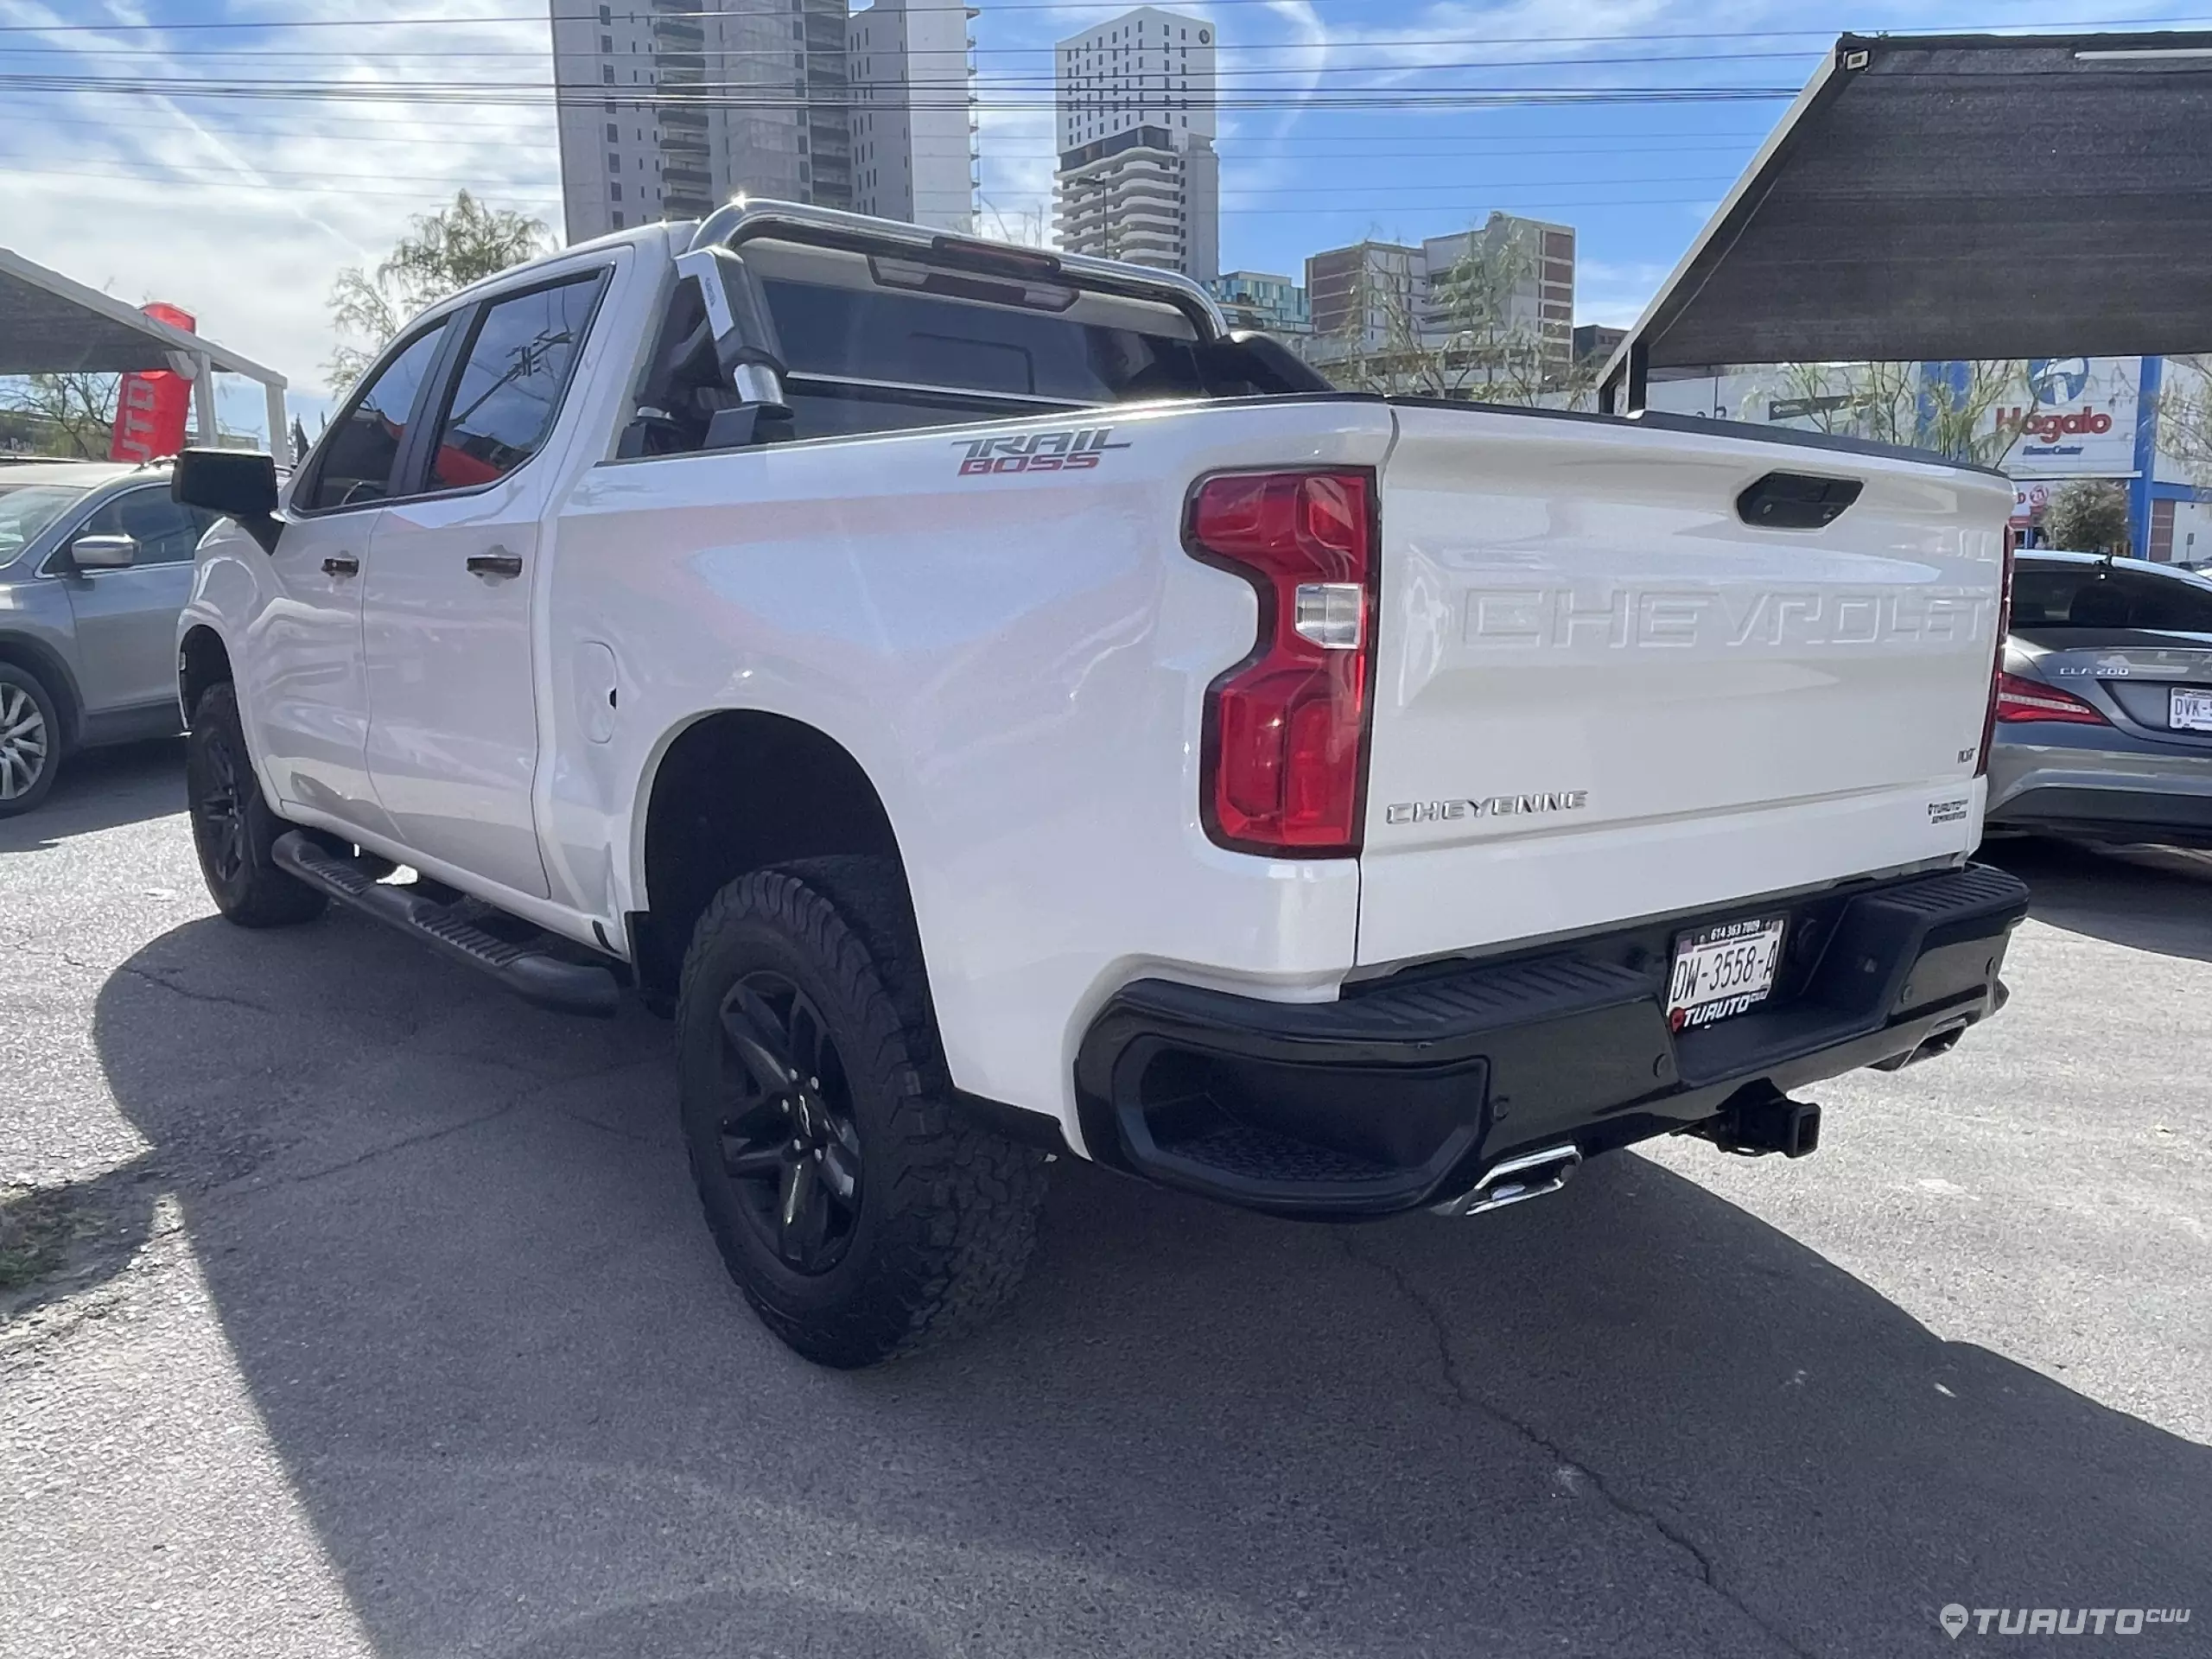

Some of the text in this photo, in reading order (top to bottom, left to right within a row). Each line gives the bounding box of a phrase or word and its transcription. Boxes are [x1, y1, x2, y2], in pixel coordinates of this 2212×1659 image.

[951, 425, 1133, 458] TRAIL
[957, 451, 1103, 476] BOSS
[1462, 588, 1991, 648] CHEVROLET
[2059, 667, 2129, 677] CLA 200
[1386, 790, 1588, 823] CHEYENNE
[1672, 940, 1778, 1002] DW-3558-A
[1683, 994, 1751, 1027] TUAUTO
